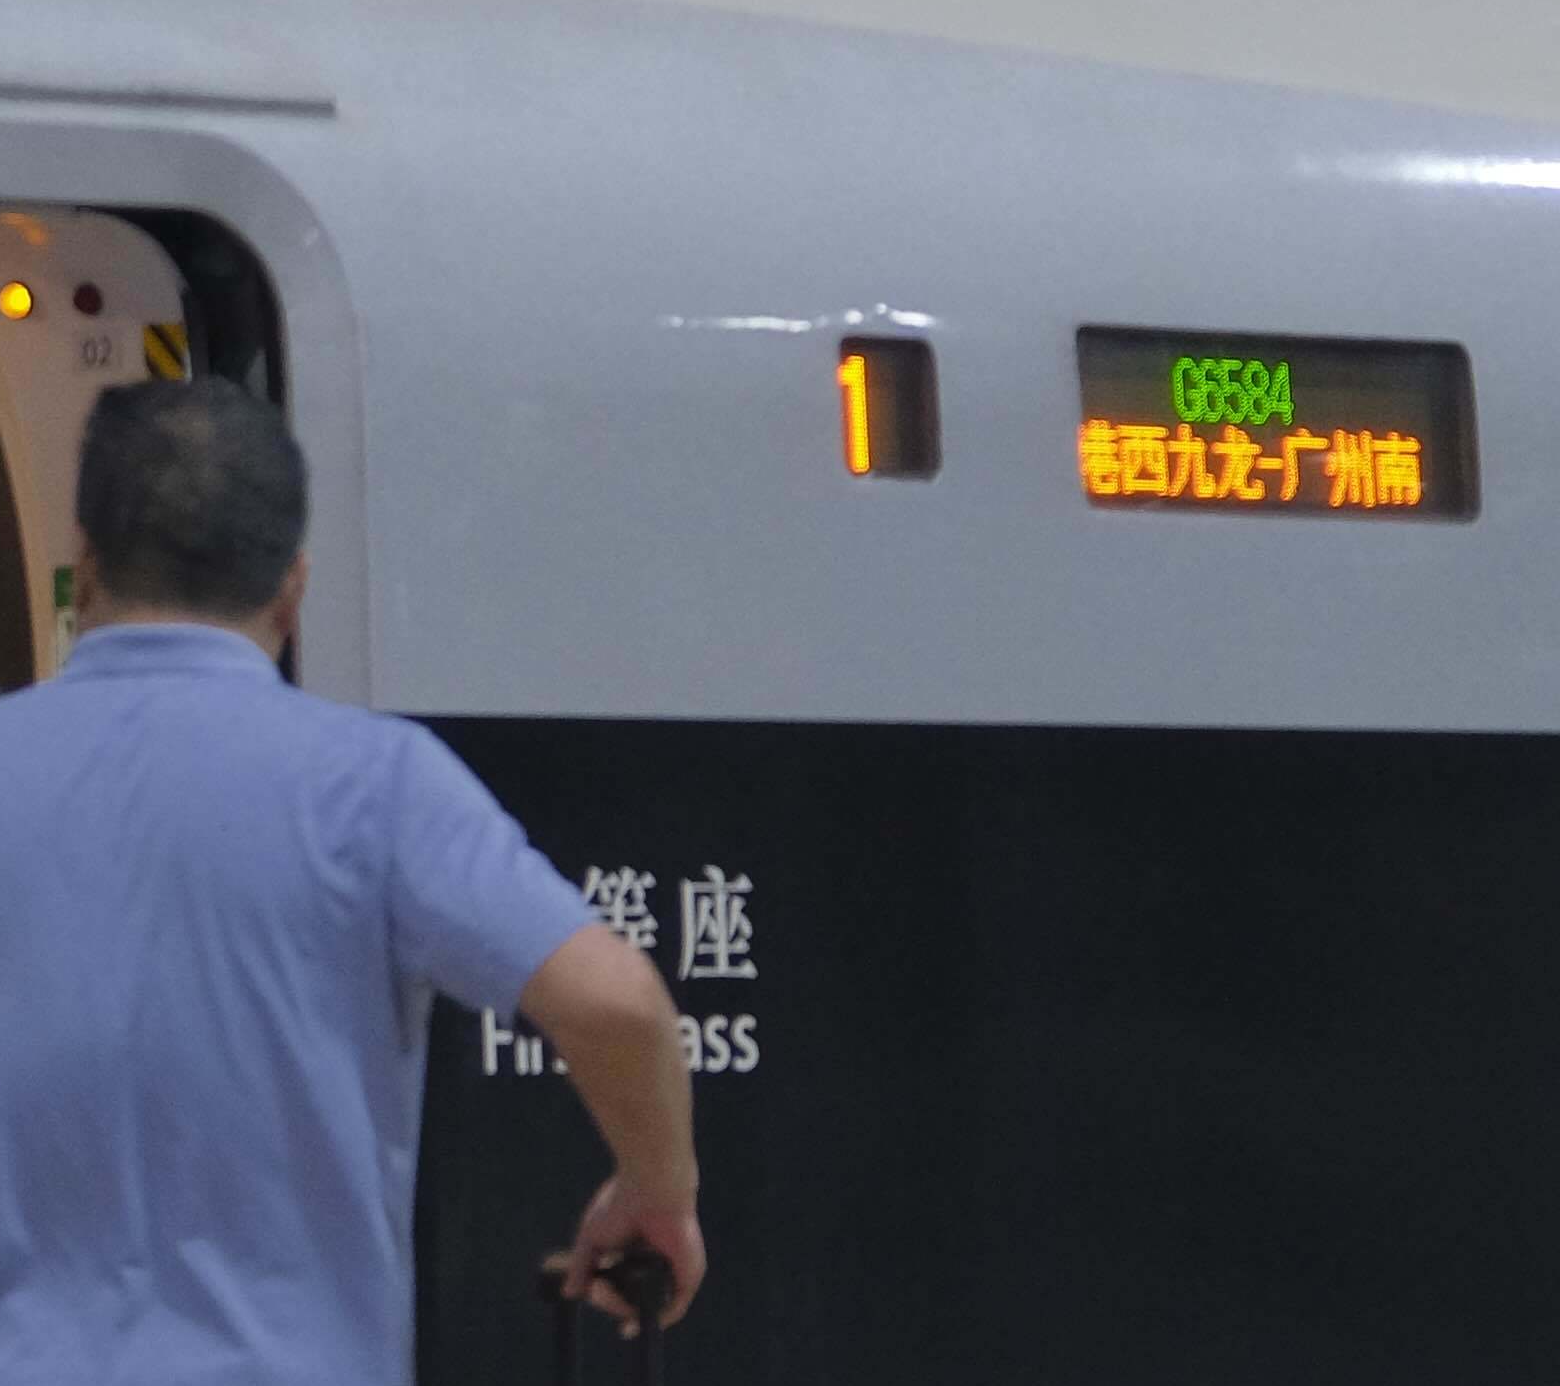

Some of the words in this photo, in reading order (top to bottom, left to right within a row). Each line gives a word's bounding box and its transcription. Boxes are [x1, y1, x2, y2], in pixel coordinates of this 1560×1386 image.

[837, 354, 871, 475] 1
[1173, 356, 1295, 426] G6584
[677, 1013, 761, 1073] ass
